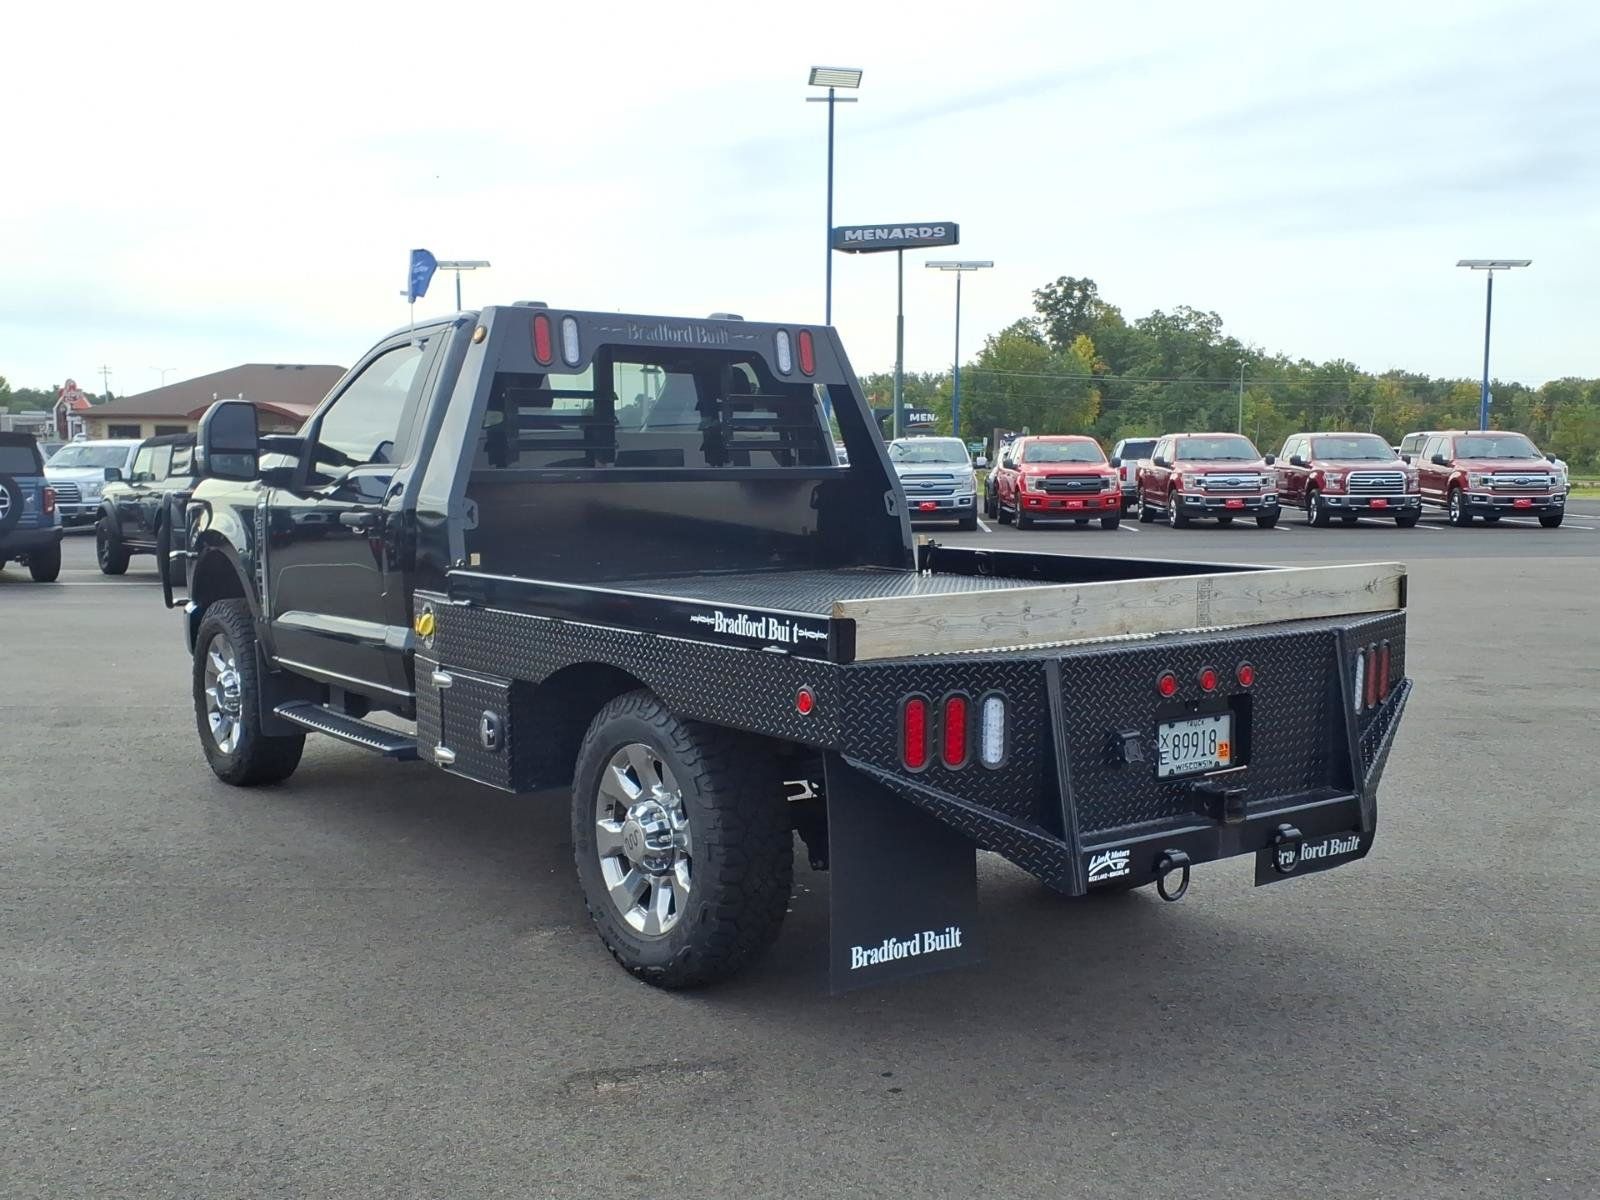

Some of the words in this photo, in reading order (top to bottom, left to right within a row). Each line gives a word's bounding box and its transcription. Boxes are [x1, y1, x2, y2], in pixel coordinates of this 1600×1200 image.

[844, 226, 946, 241] MENARDS
[627, 321, 693, 344] Bradford
[697, 326, 729, 344] Built
[713, 610, 766, 640] Bradford
[1172, 729, 1217, 761] 89918
[1176, 759, 1213, 771] WISCONSIN
[1328, 836, 1361, 857] Built
[850, 932, 921, 970] Bradford
[922, 926, 962, 954] Built
